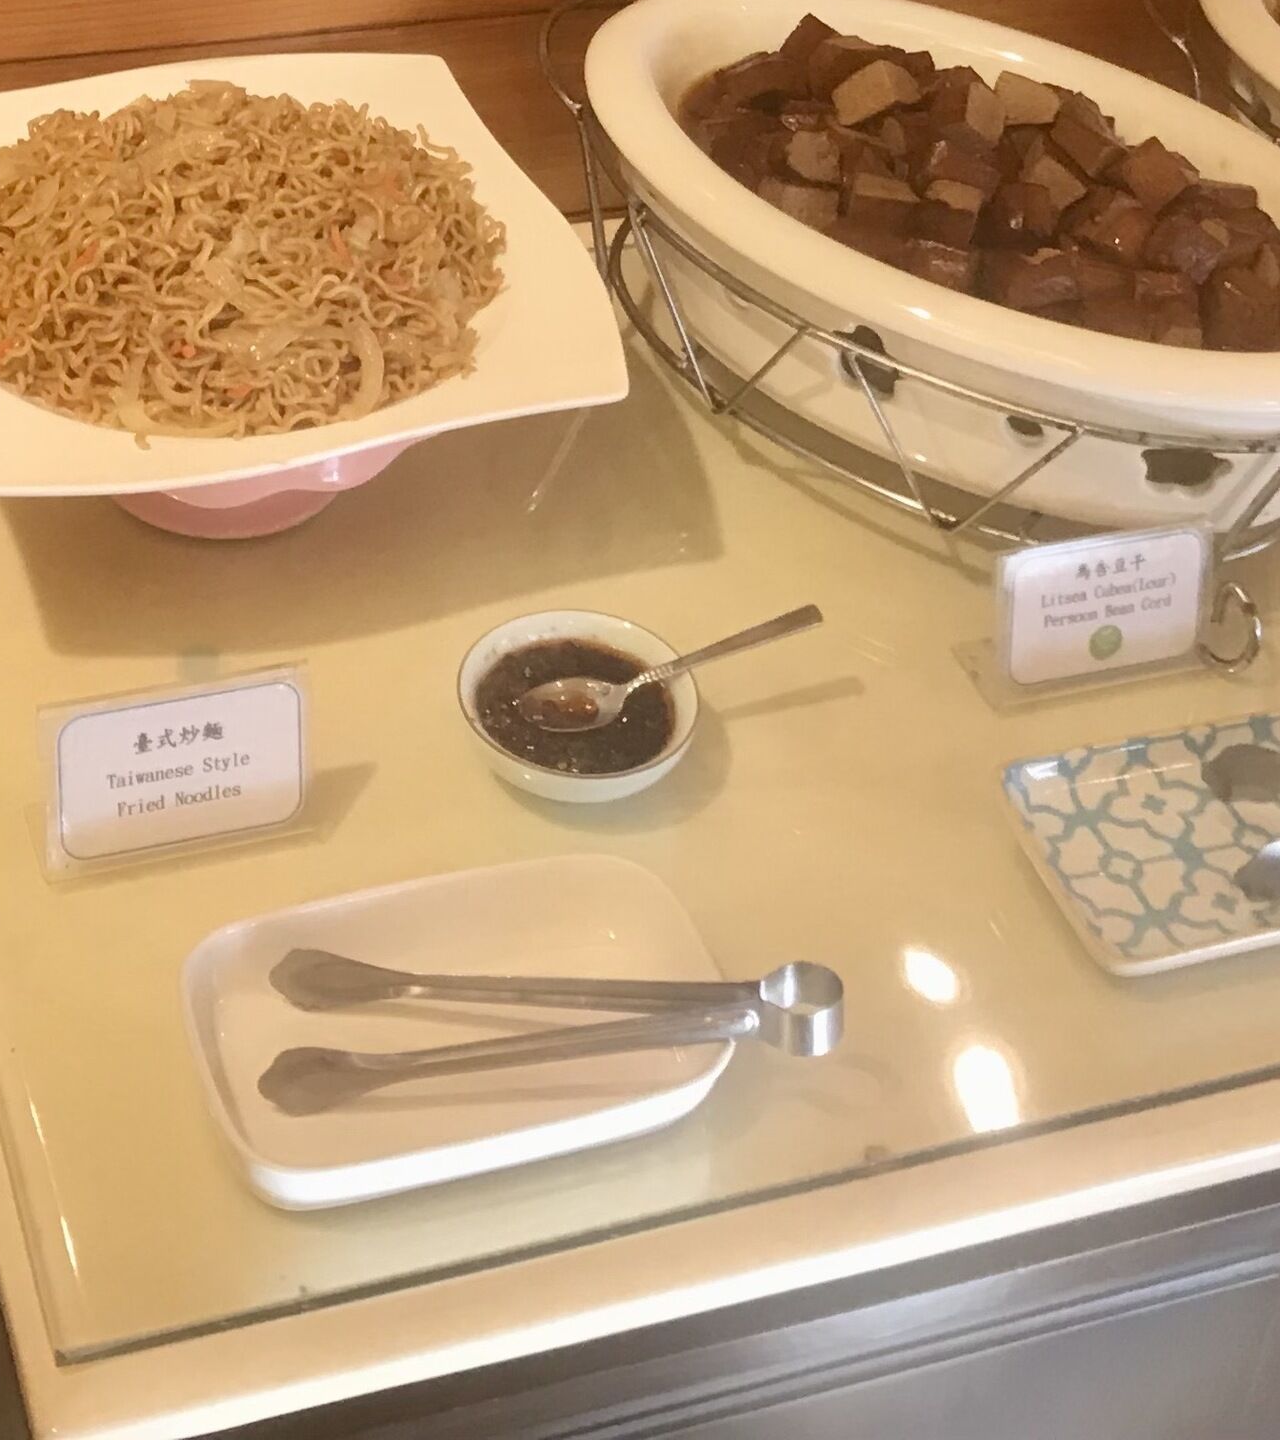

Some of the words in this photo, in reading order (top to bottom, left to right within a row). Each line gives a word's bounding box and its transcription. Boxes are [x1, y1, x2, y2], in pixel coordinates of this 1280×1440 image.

[107, 762, 194, 790] Taiwanese
[202, 751, 251, 773] Style
[117, 794, 166, 818] Fried
[175, 783, 242, 807] Noodles
